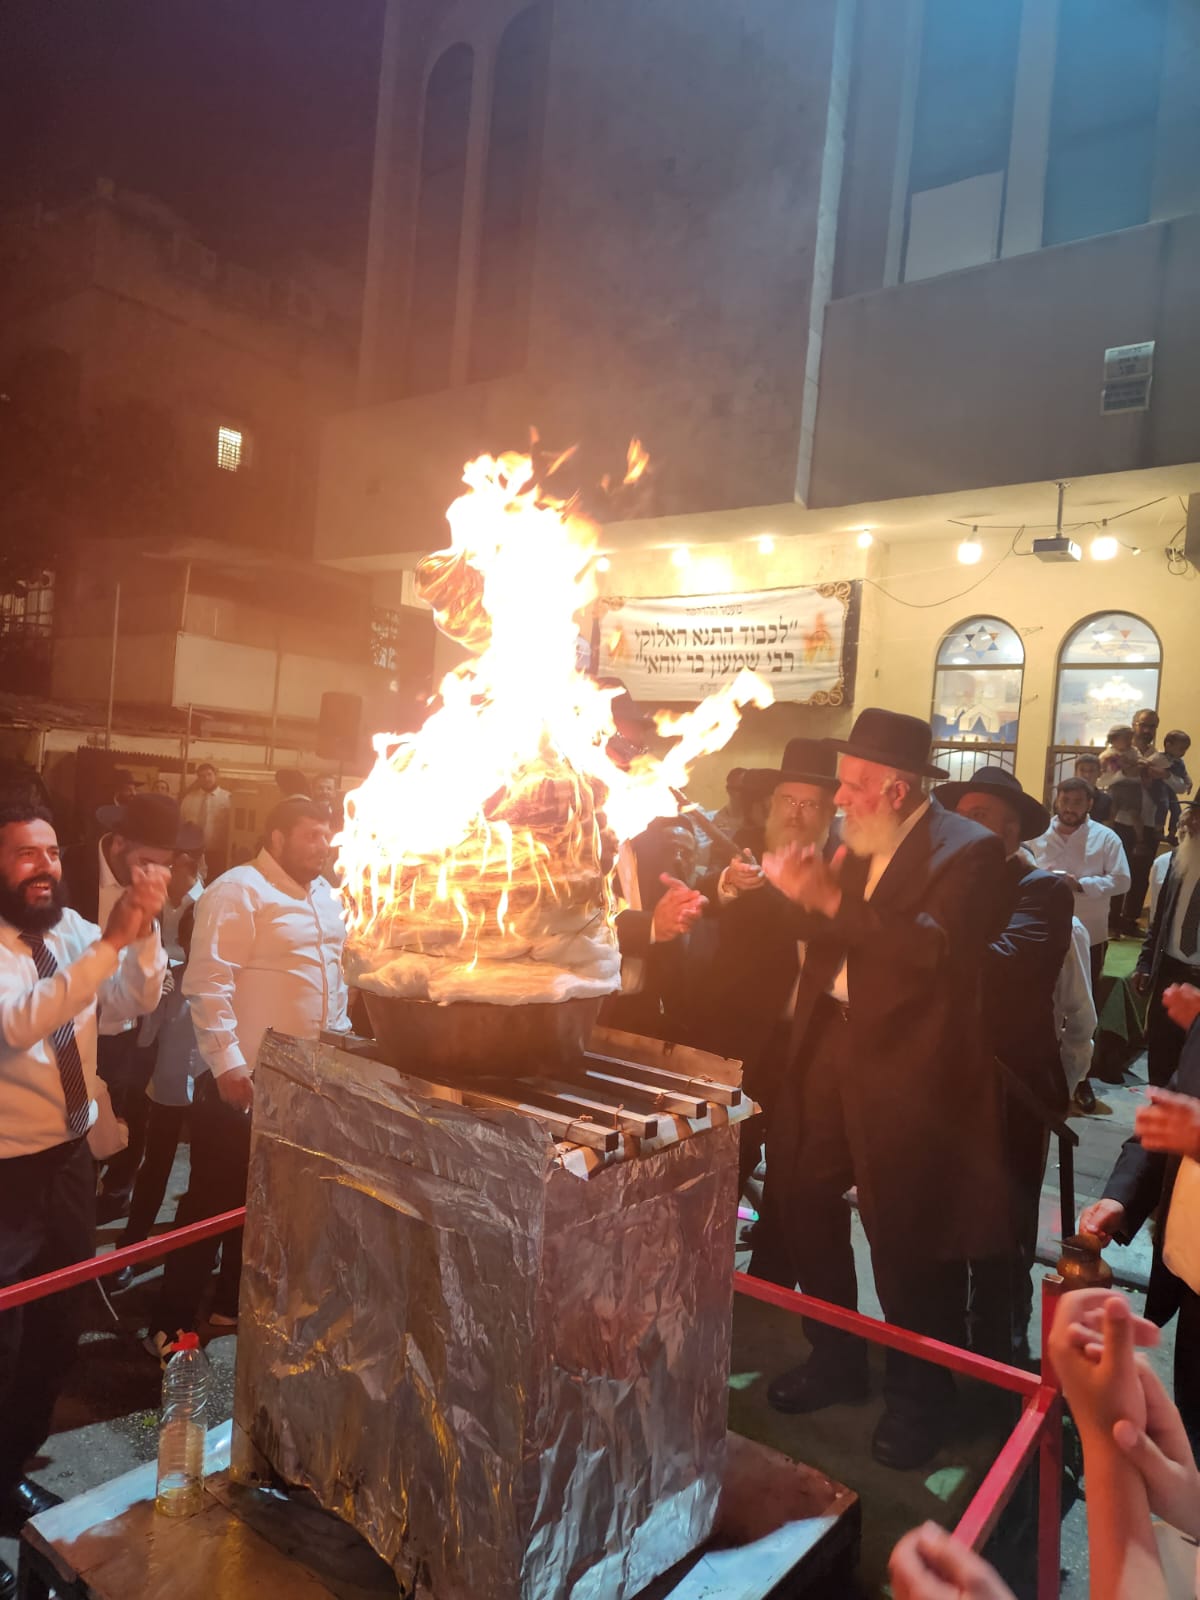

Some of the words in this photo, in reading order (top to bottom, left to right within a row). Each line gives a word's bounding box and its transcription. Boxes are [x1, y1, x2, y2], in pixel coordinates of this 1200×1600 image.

[634, 621, 687, 655] האלוקי
[692, 626, 733, 646] התנא
[686, 654, 705, 673] בר
[710, 652, 761, 679] שמעון
[768, 650, 794, 673] רבי
